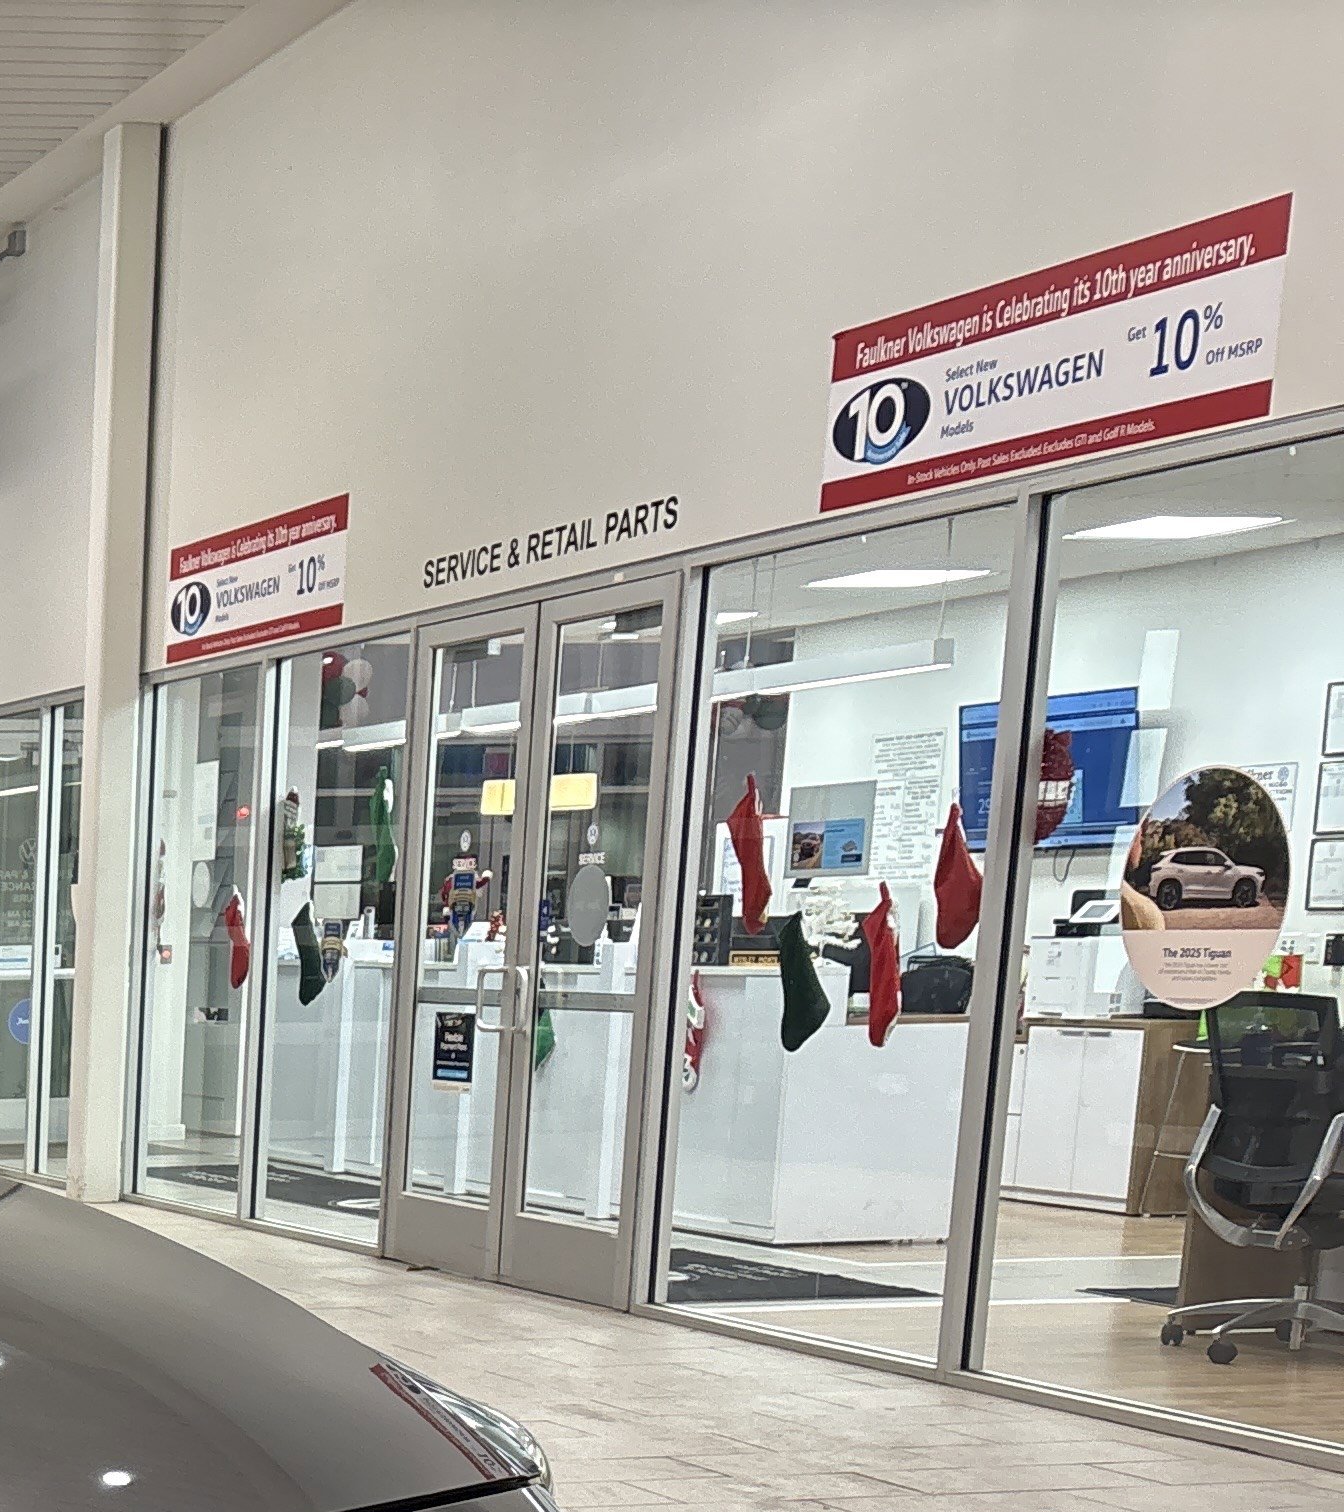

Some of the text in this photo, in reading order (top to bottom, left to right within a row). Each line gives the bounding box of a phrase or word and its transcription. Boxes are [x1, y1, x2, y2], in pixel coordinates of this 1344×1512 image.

[855, 335, 906, 369] Faulkner
[907, 314, 980, 355] Volkswagen
[982, 305, 993, 332] is
[995, 284, 1071, 329] Celebrating
[1093, 263, 1127, 300] 10th
[1127, 263, 1162, 299] year
[1162, 233, 1256, 281] anniversary.
[1127, 326, 1147, 342] Get
[1205, 337, 1264, 366] Off MSRP
[944, 348, 1105, 416] VOLKSWAGEN
[945, 358, 998, 383] Select New
[849, 383, 905, 461] 10
[940, 419, 974, 439] Models
[1087, 429, 1103, 445] and
[288, 525, 302, 546] year
[423, 495, 679, 589] SERVICE & RETAIL PARTS
[215, 575, 281, 609] VOLKSWAGEN
[177, 584, 201, 632] 10
[452, 857, 477, 871] SERVICE
[578, 851, 605, 866] SERVICE
[1162, 947, 1232, 961] The 2025 Tiguan
